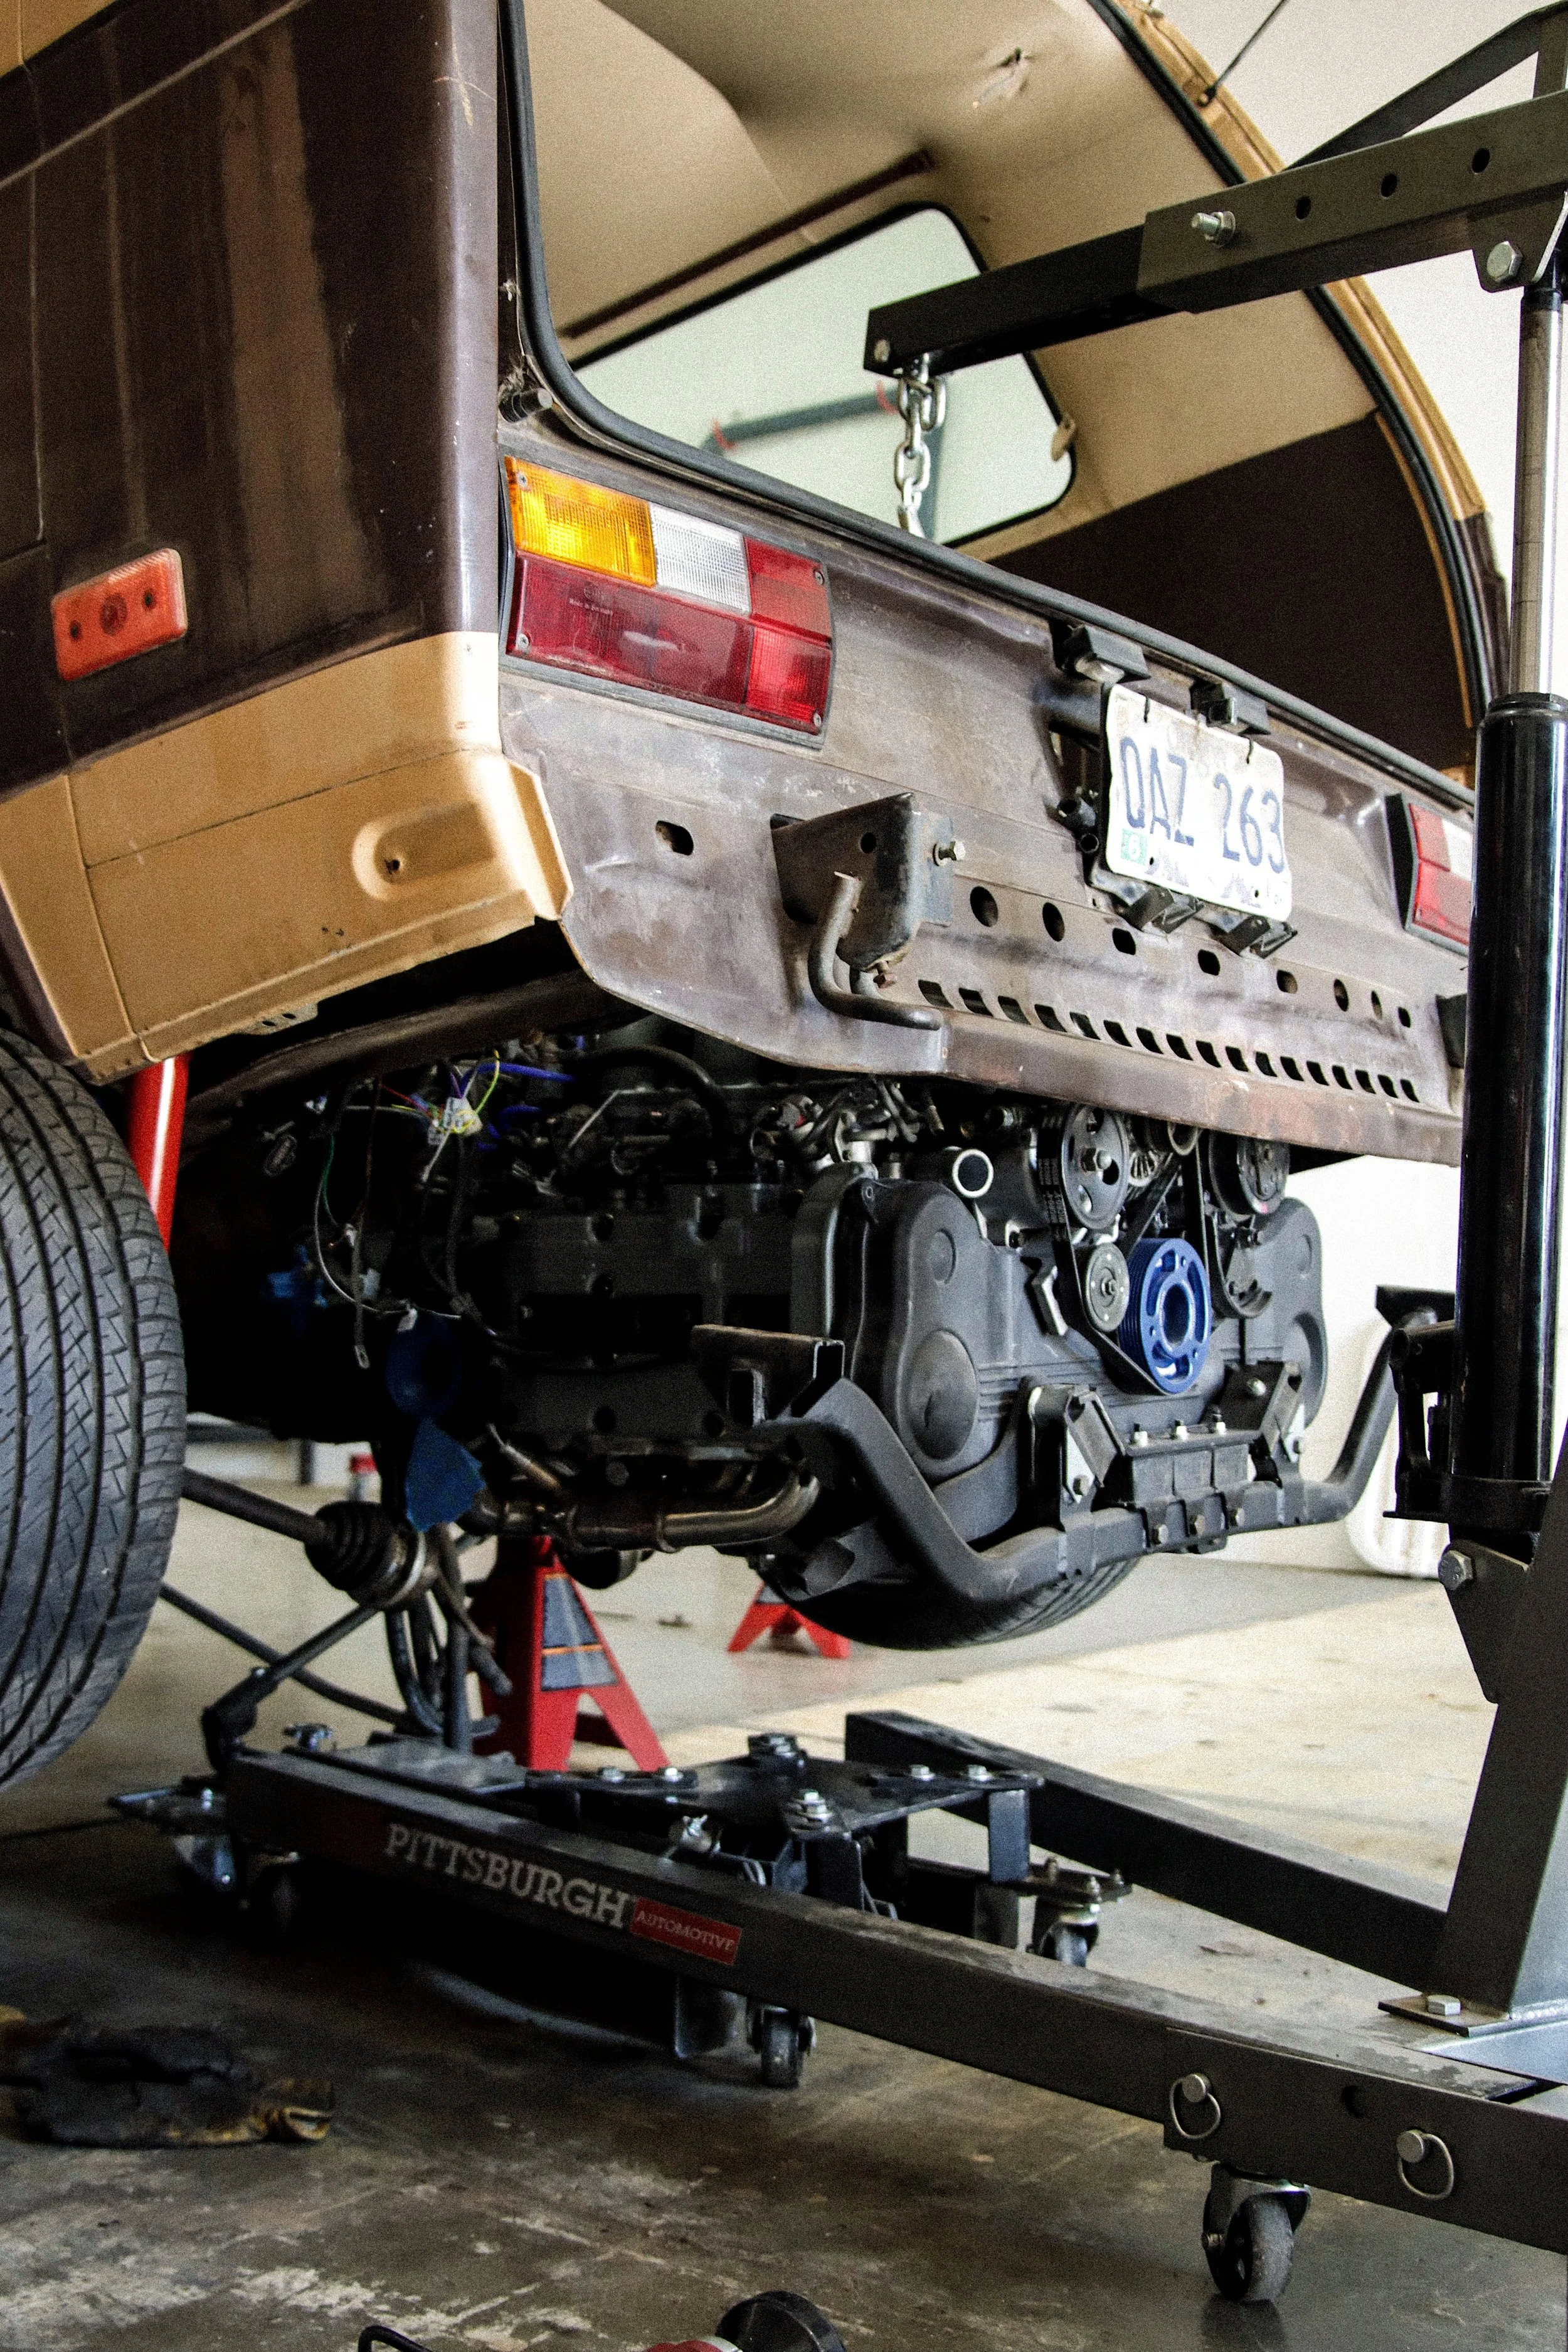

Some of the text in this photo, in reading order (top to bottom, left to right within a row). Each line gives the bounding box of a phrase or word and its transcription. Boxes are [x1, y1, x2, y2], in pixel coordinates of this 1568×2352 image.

[1212, 773, 1285, 874] 263
[384, 1823, 735, 1951] PITTSBURGH AUTOMOTIVE
